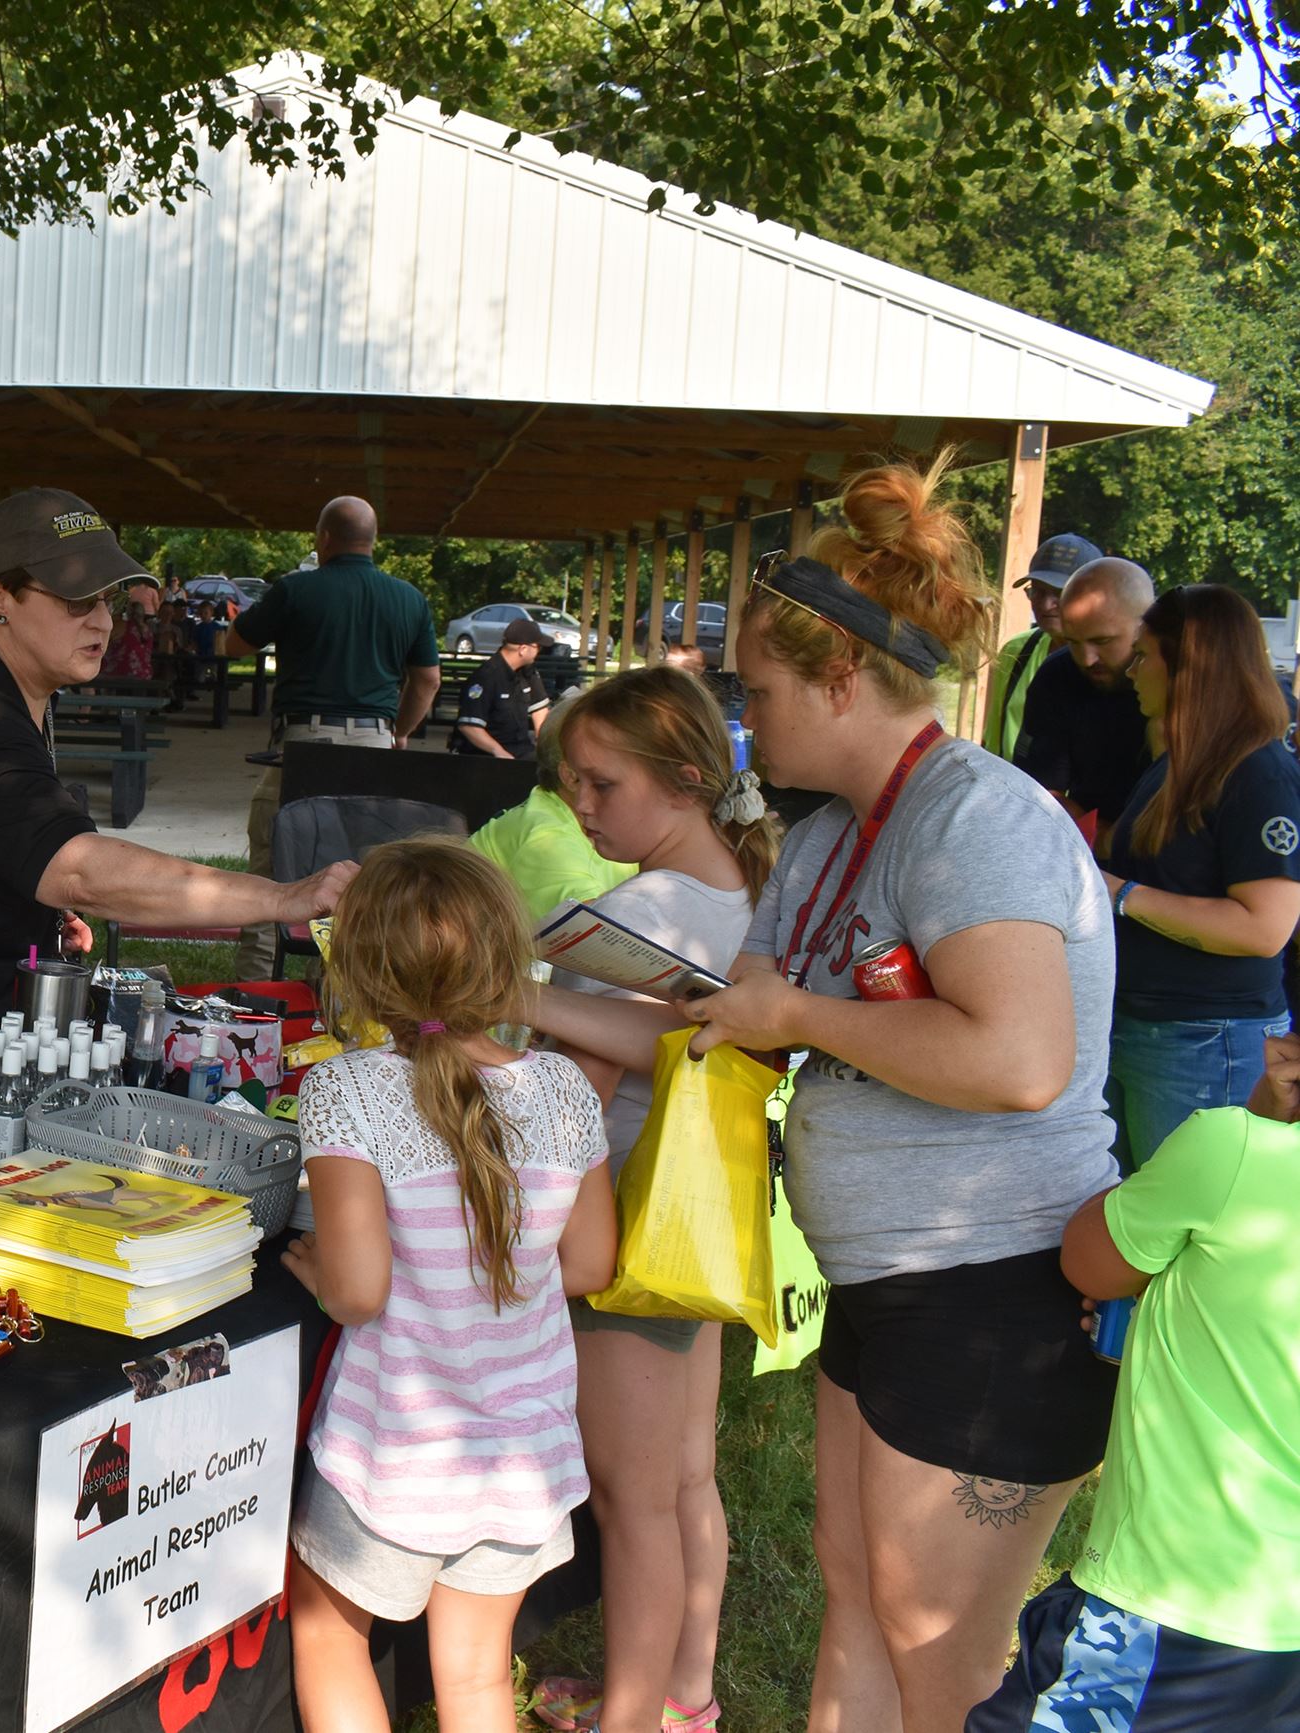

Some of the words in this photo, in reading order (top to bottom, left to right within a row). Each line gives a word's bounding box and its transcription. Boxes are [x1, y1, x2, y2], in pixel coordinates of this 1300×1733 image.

[59, 514, 95, 532] EMA
[646, 1230, 662, 1275] DISCOVER
[655, 1209, 665, 1228] THE
[660, 1153, 677, 1209] ADVENTURE
[83, 1465, 129, 1497] RESPONSE
[84, 1453, 130, 1484] ANIMAL
[107, 1477, 128, 1497] TEAM
[137, 1469, 196, 1516] Butler
[205, 1437, 268, 1482] County
[85, 1536, 159, 1602] Animal
[167, 1494, 259, 1558] Response
[143, 1581, 199, 1626] Team
